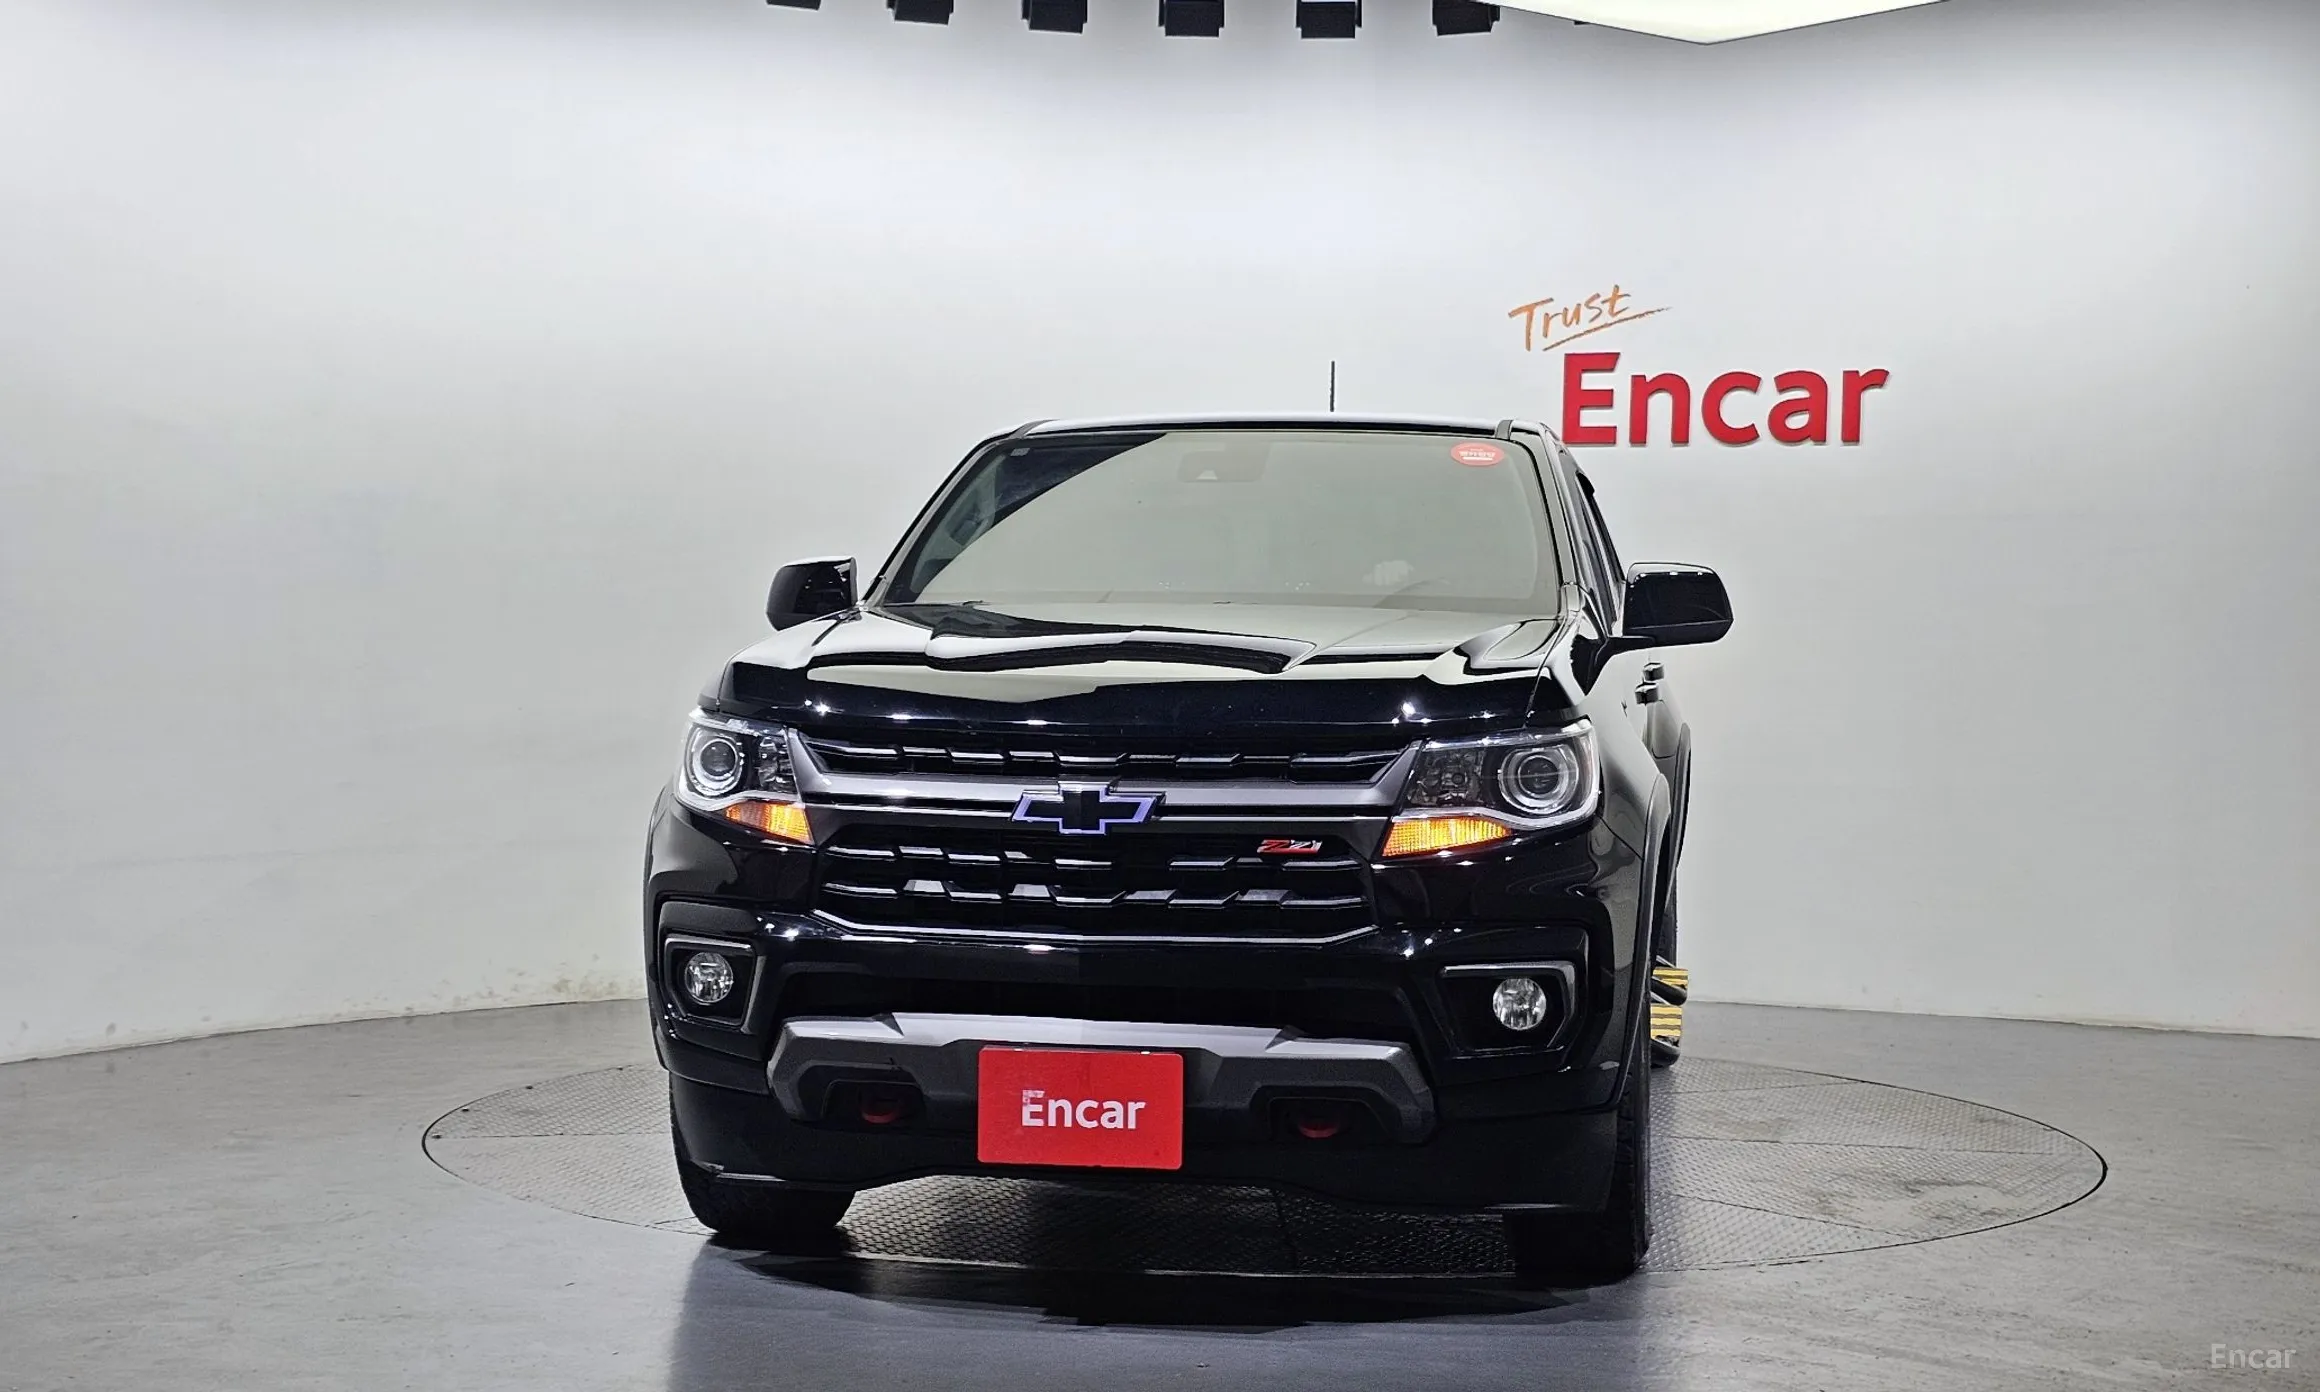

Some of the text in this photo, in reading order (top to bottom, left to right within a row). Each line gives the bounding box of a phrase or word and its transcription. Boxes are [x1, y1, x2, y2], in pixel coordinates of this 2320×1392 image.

[1508, 284, 1632, 351] Trust
[1562, 352, 1890, 445] Encar
[1257, 839, 1322, 853] Z71
[1022, 1089, 1146, 1129] Encar
